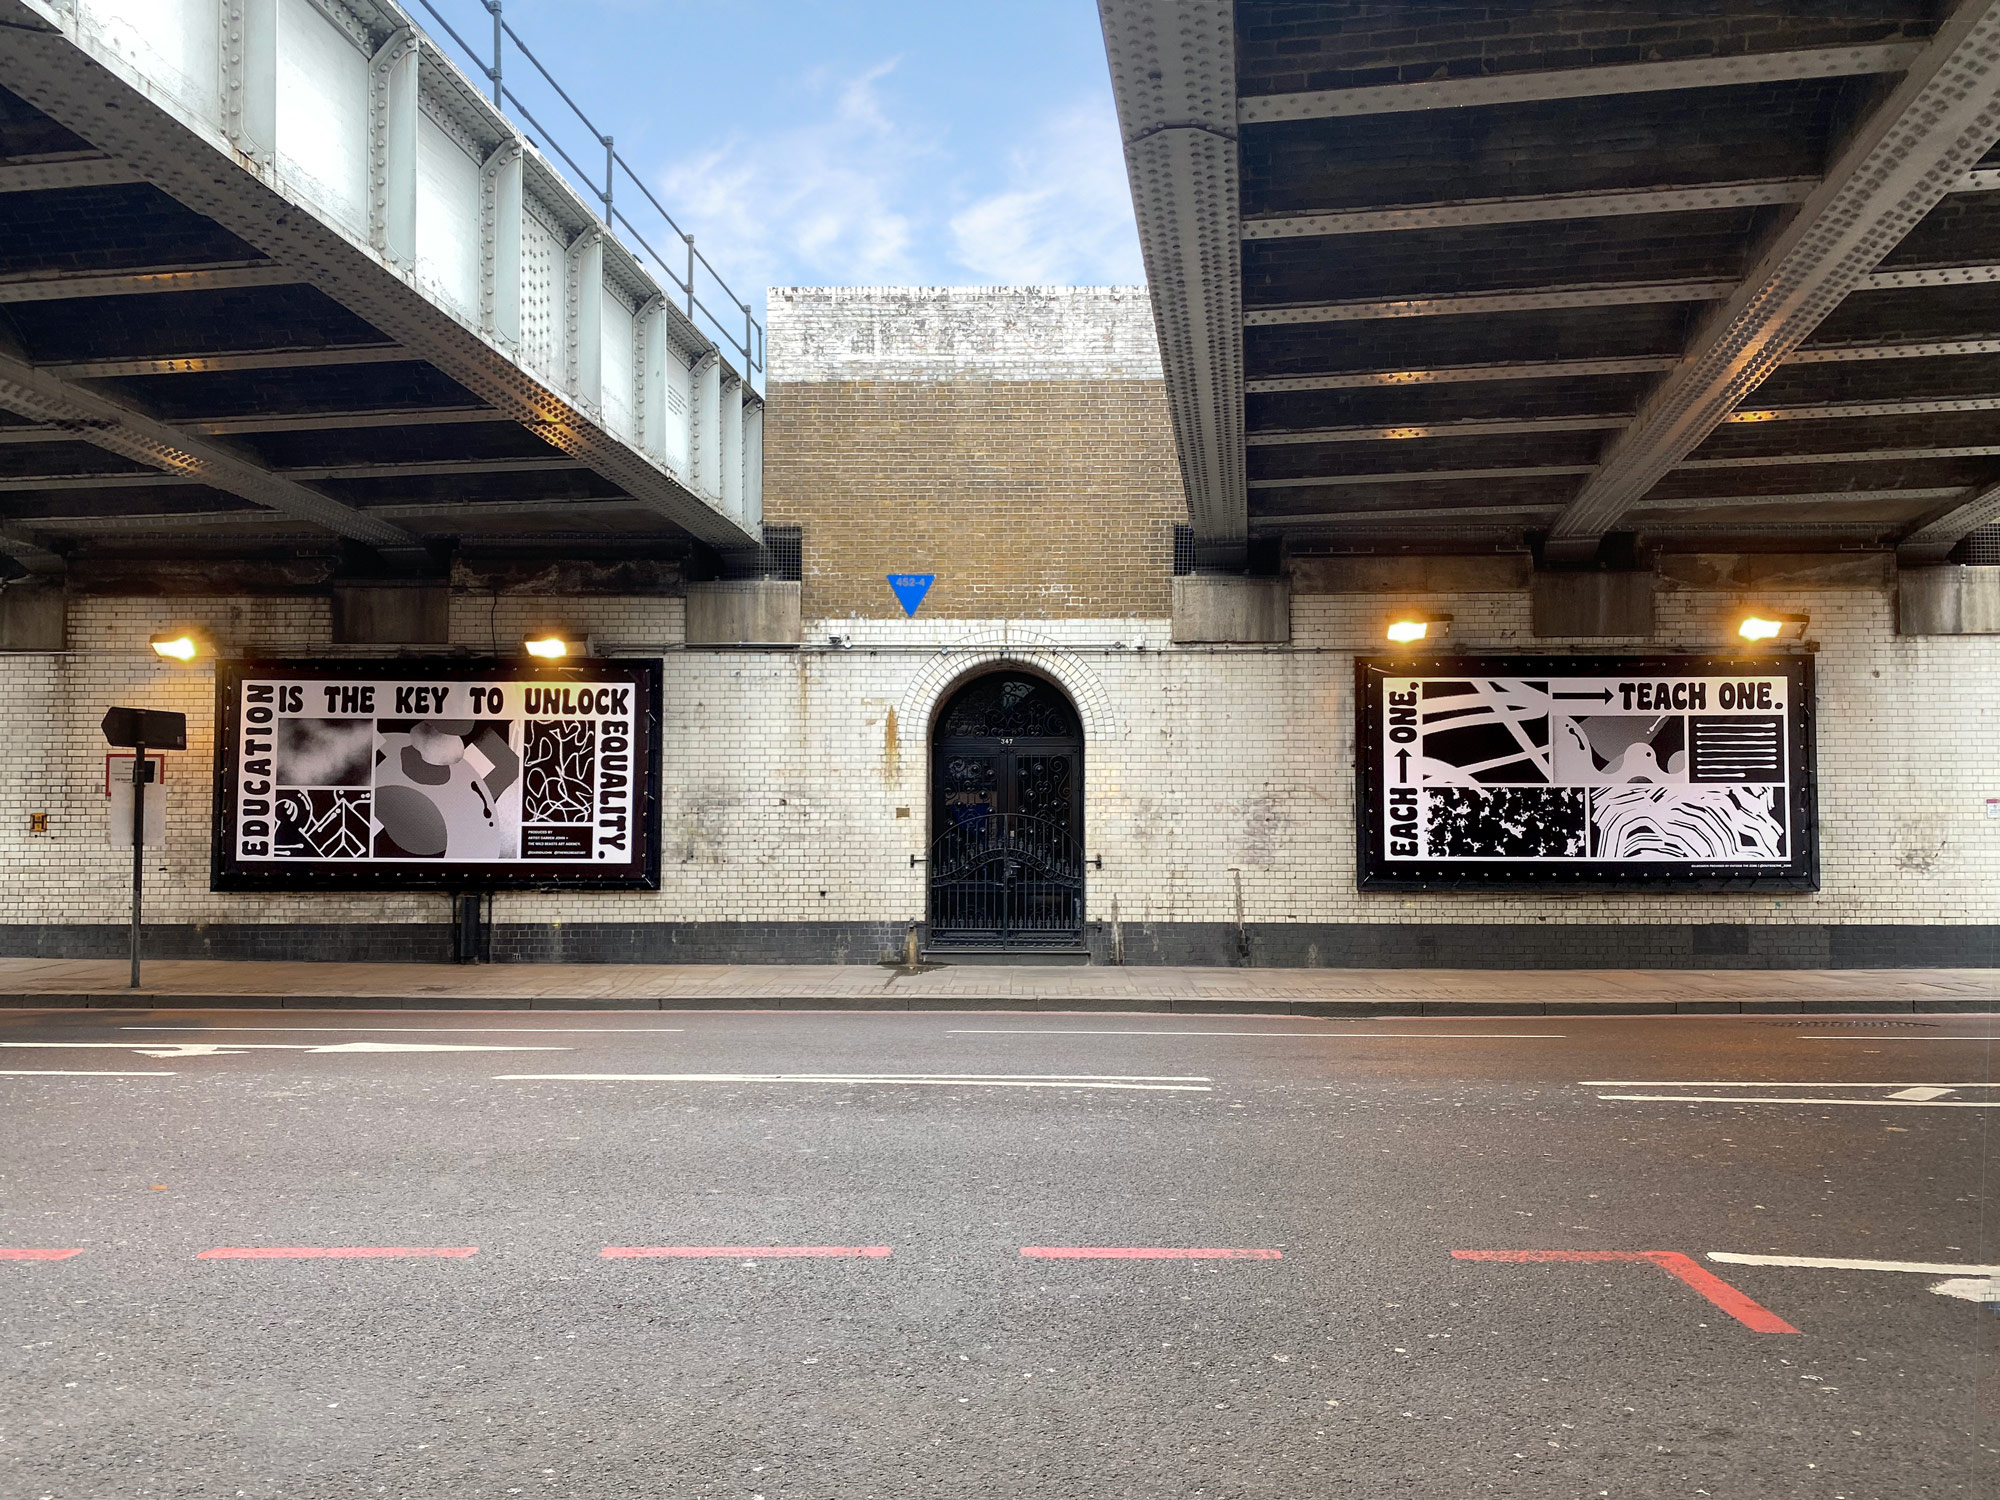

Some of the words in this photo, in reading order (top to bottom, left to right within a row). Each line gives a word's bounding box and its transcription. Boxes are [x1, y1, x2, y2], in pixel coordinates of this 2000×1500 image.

[895, 577, 925, 587] 452-4
[279, 686, 303, 713] IS
[324, 686, 375, 714] THE
[395, 686, 449, 714] KEY
[470, 687, 504, 714] TO
[524, 688, 629, 716] UNLOCK
[1389, 681, 1420, 744] ONE,
[1618, 682, 1707, 711] TEACH
[1718, 682, 1784, 710] ONE.
[242, 685, 273, 857] EDUCATION
[599, 720, 628, 859] EQUALITY.
[32, 814, 44, 830] H
[1389, 788, 1419, 857] EACH
